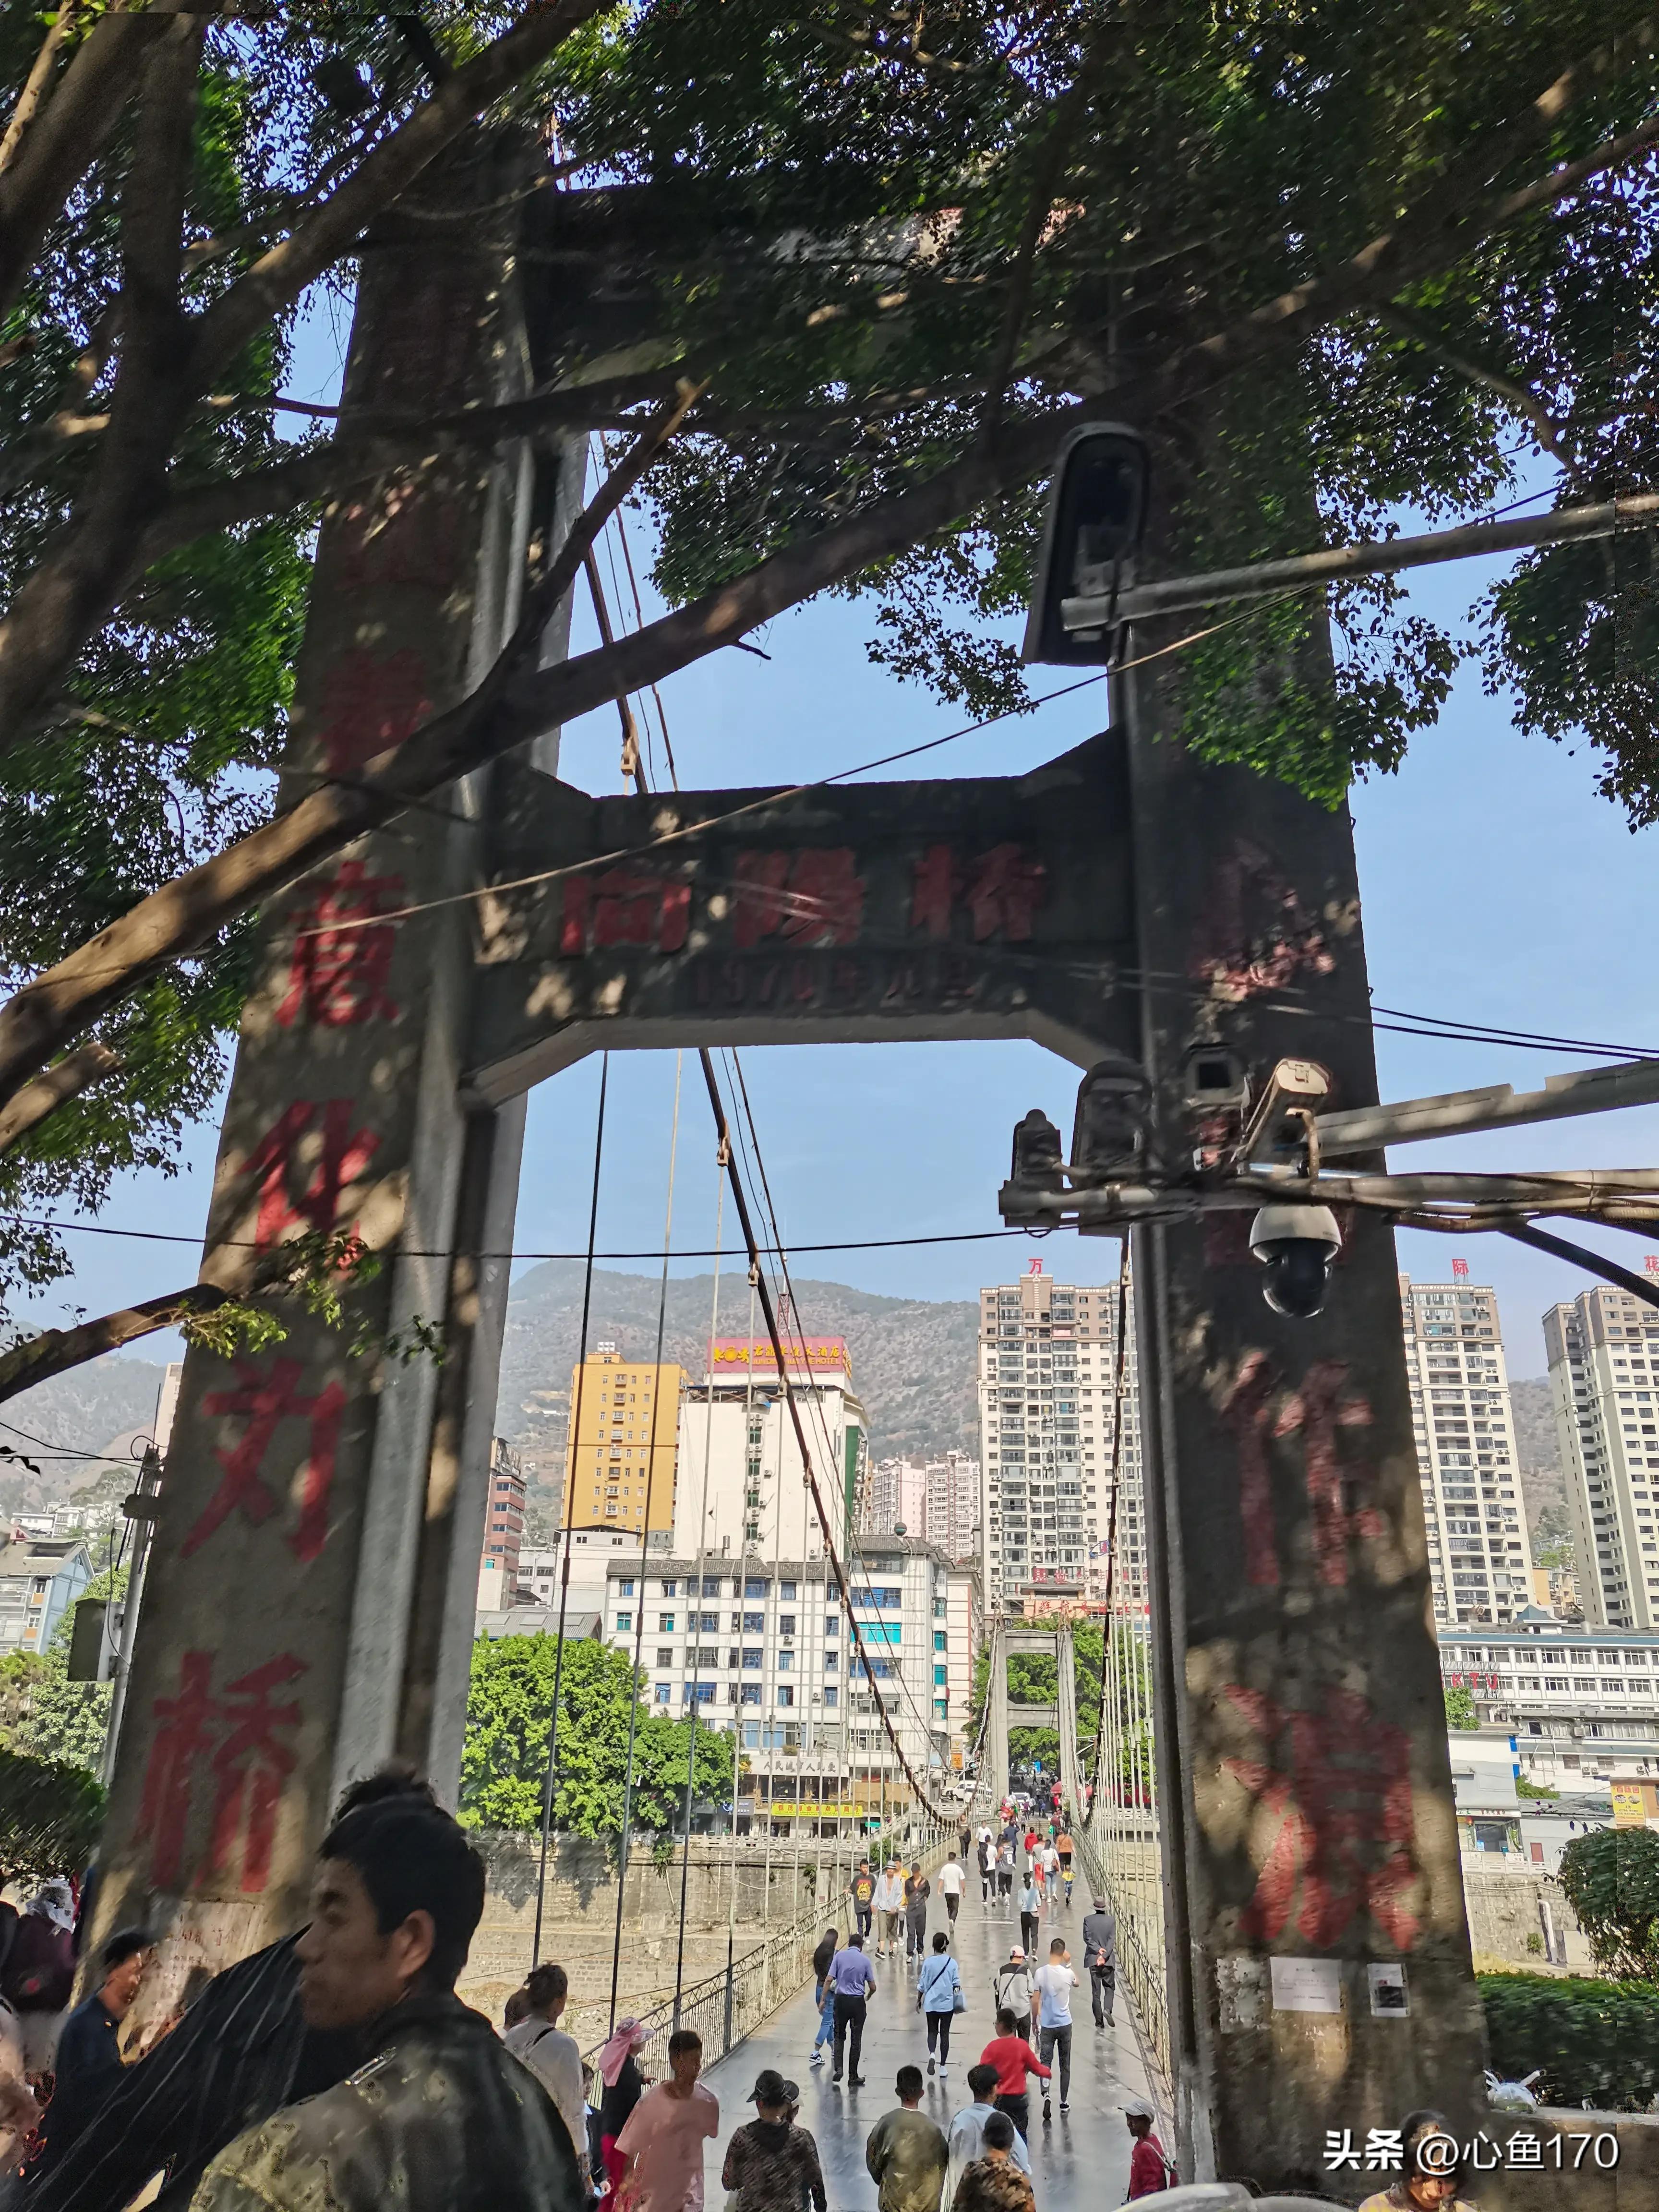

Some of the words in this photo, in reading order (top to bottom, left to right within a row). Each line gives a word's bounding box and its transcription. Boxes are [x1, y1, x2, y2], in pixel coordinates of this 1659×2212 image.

[1028, 1258, 1043, 1274] 万
[1452, 1259, 1469, 1276] 际
[1452, 1672, 1497, 1690] KTV
